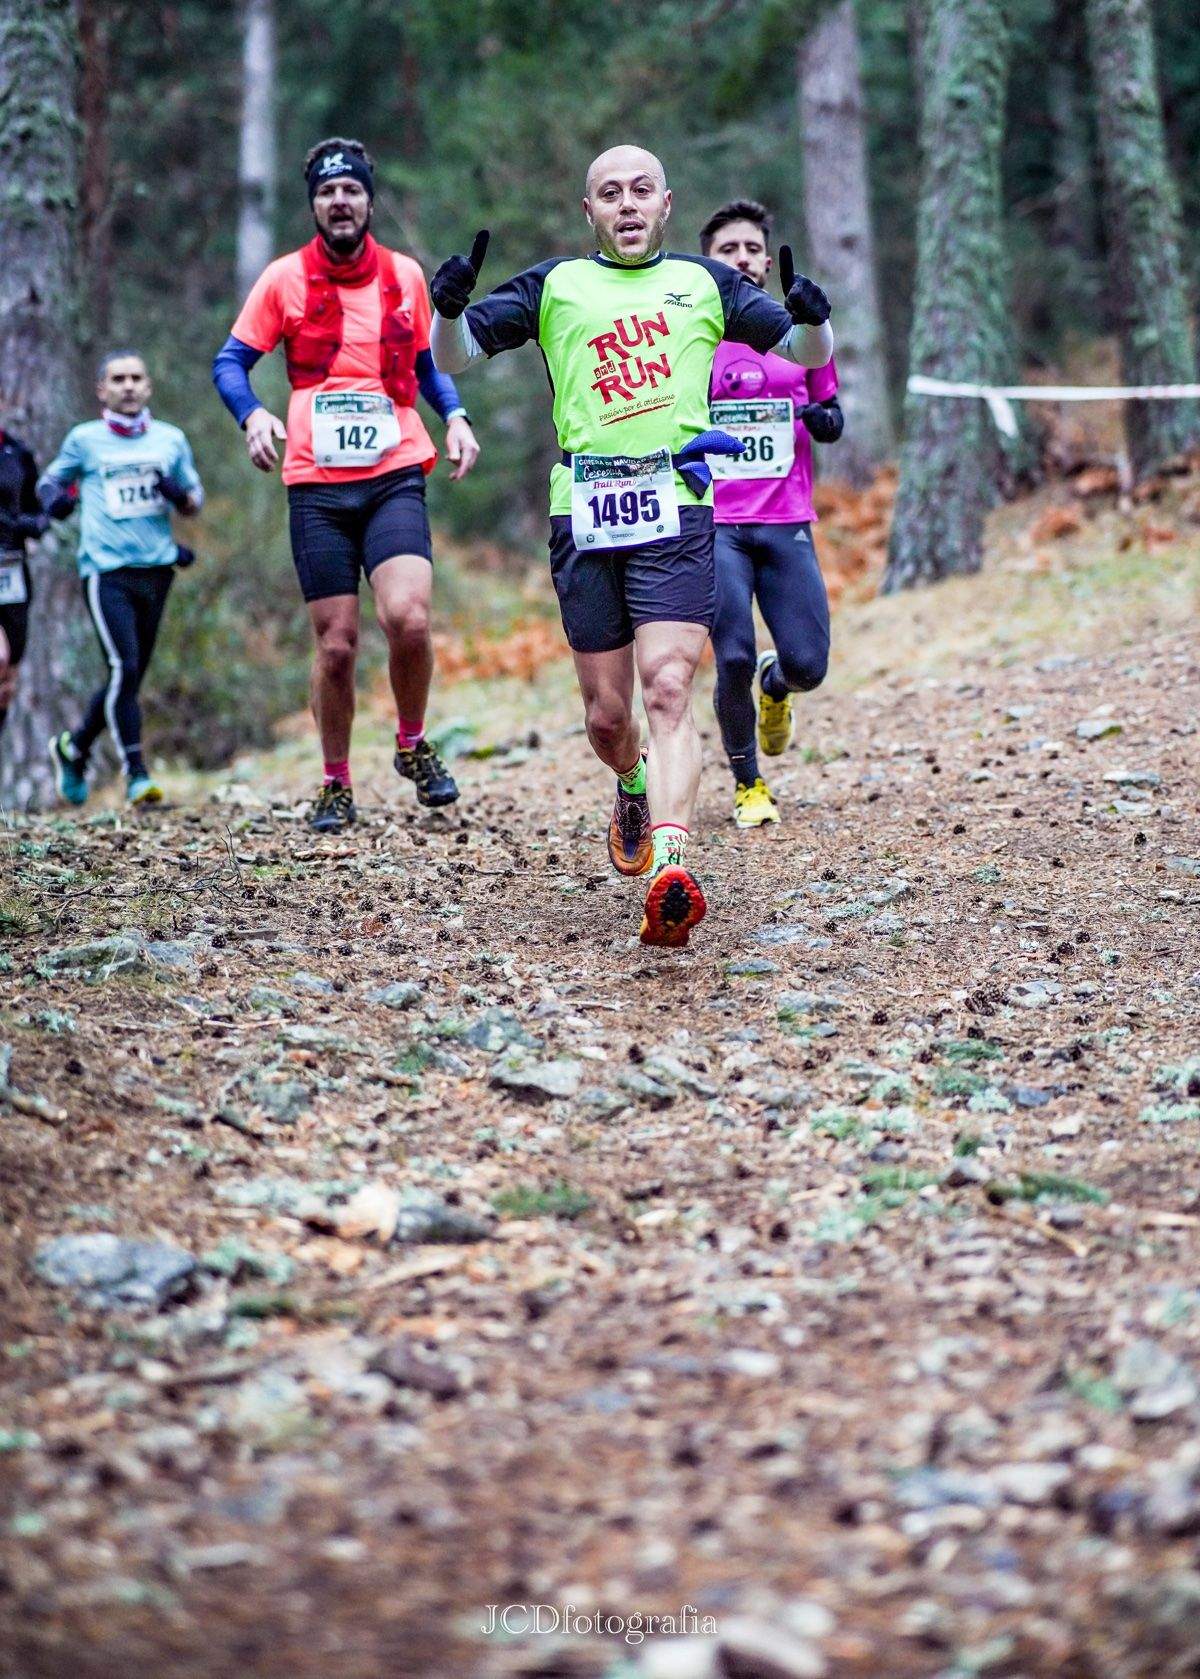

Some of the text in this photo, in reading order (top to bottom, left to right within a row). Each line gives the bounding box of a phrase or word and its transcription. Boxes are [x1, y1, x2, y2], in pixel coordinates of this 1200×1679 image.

[587, 311, 670, 362] RUN
[591, 352, 671, 405] RUN
[593, 360, 616, 380] and
[335, 425, 378, 450] 142
[593, 480, 613, 489] Trail
[587, 489, 661, 529] 1495
